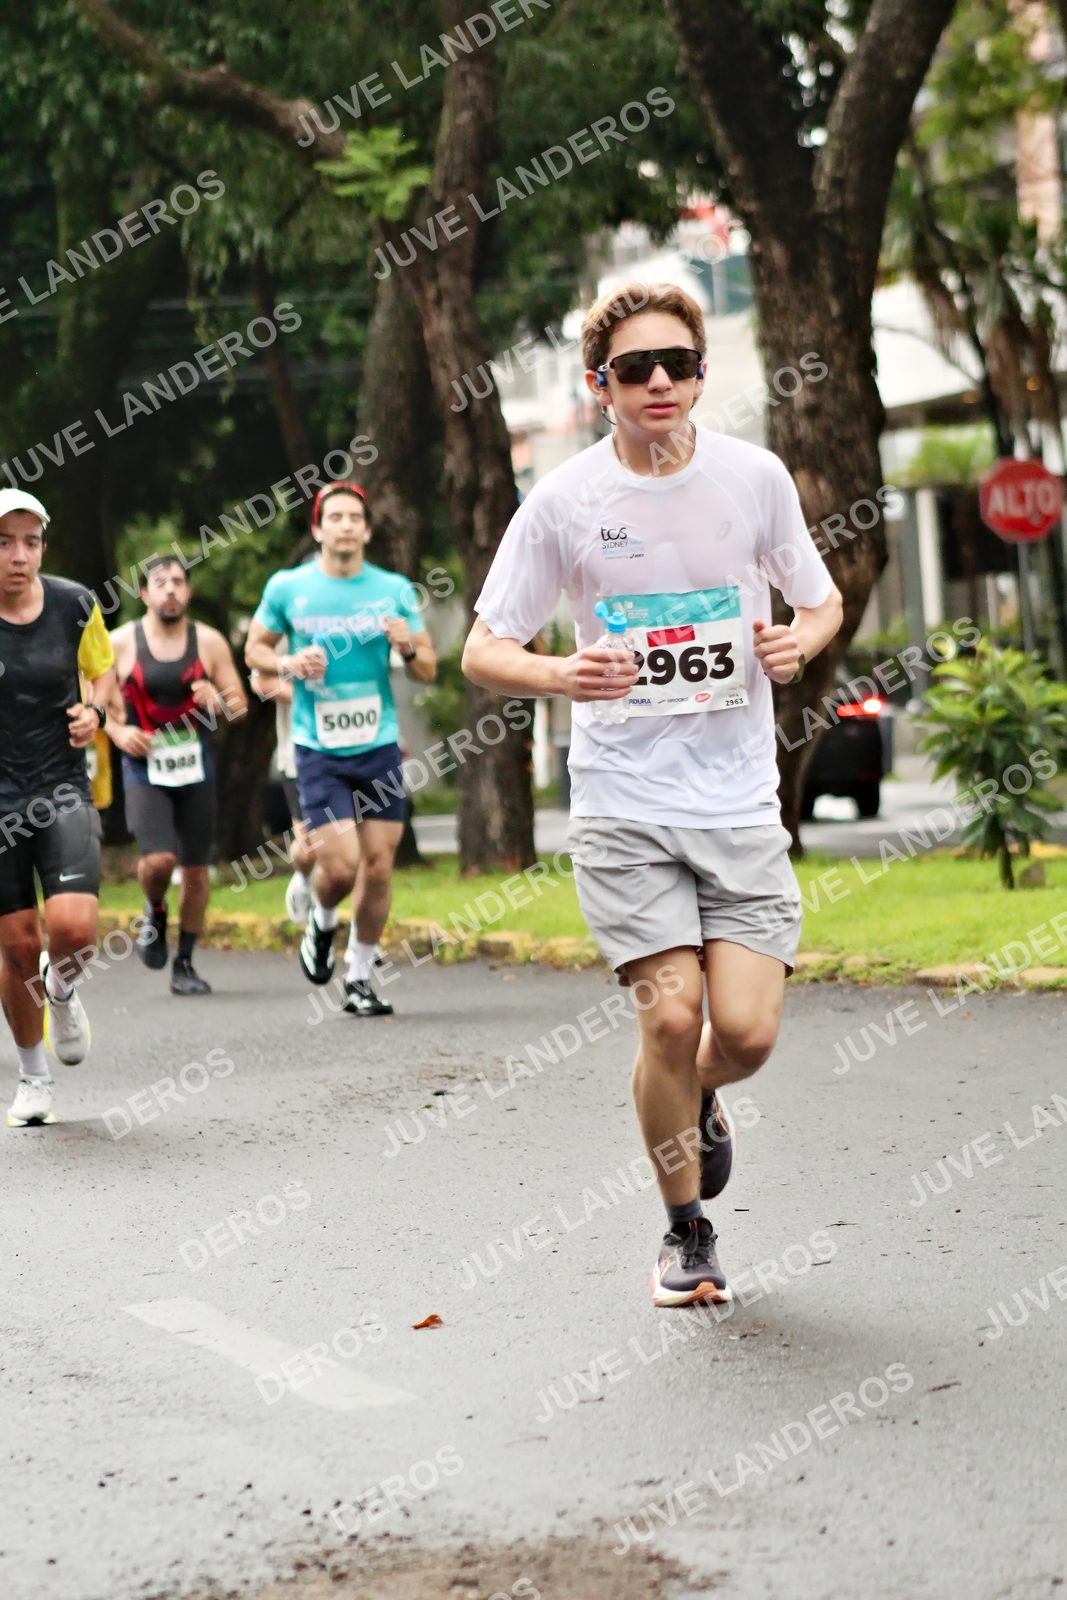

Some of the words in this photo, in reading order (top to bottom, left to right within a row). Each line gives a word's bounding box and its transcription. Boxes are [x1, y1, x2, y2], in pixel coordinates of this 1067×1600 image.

[987, 480, 1054, 518] ALTO
[601, 540, 628, 550] SYDNEY
[725, 698, 744, 706] 2963
[322, 709, 377, 731] 5000
